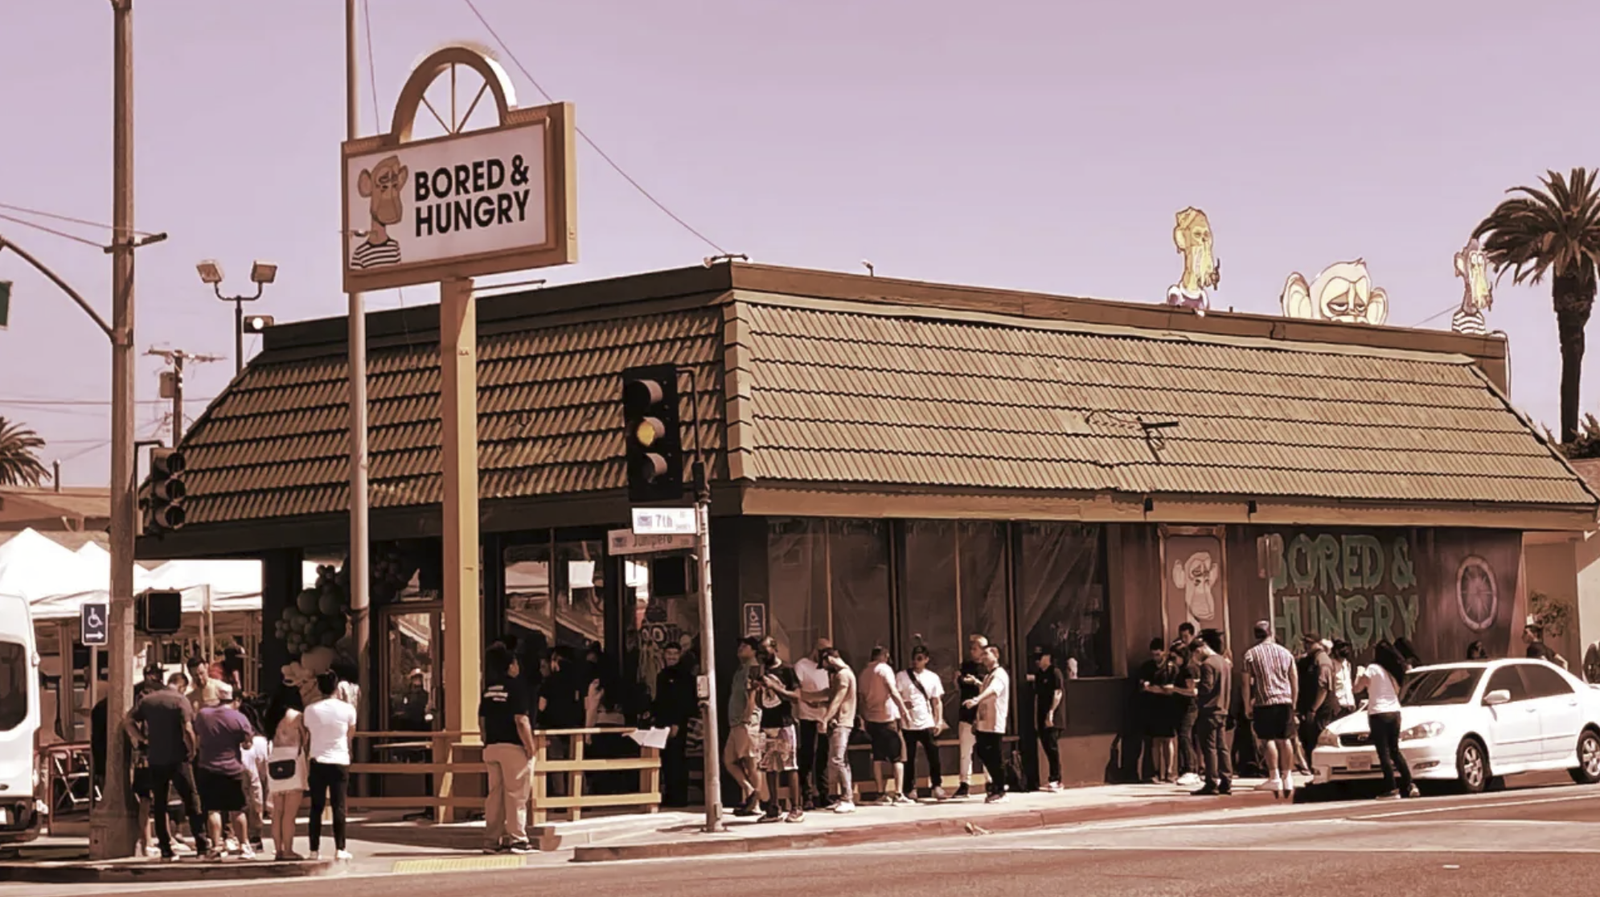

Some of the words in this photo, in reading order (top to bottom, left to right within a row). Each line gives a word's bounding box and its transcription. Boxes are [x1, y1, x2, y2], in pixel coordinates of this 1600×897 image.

[414, 157, 506, 202] BORED
[510, 154, 530, 187] &
[415, 188, 530, 238] HUNGRY
[655, 514, 673, 528] 7th
[1391, 536, 1418, 590] &
